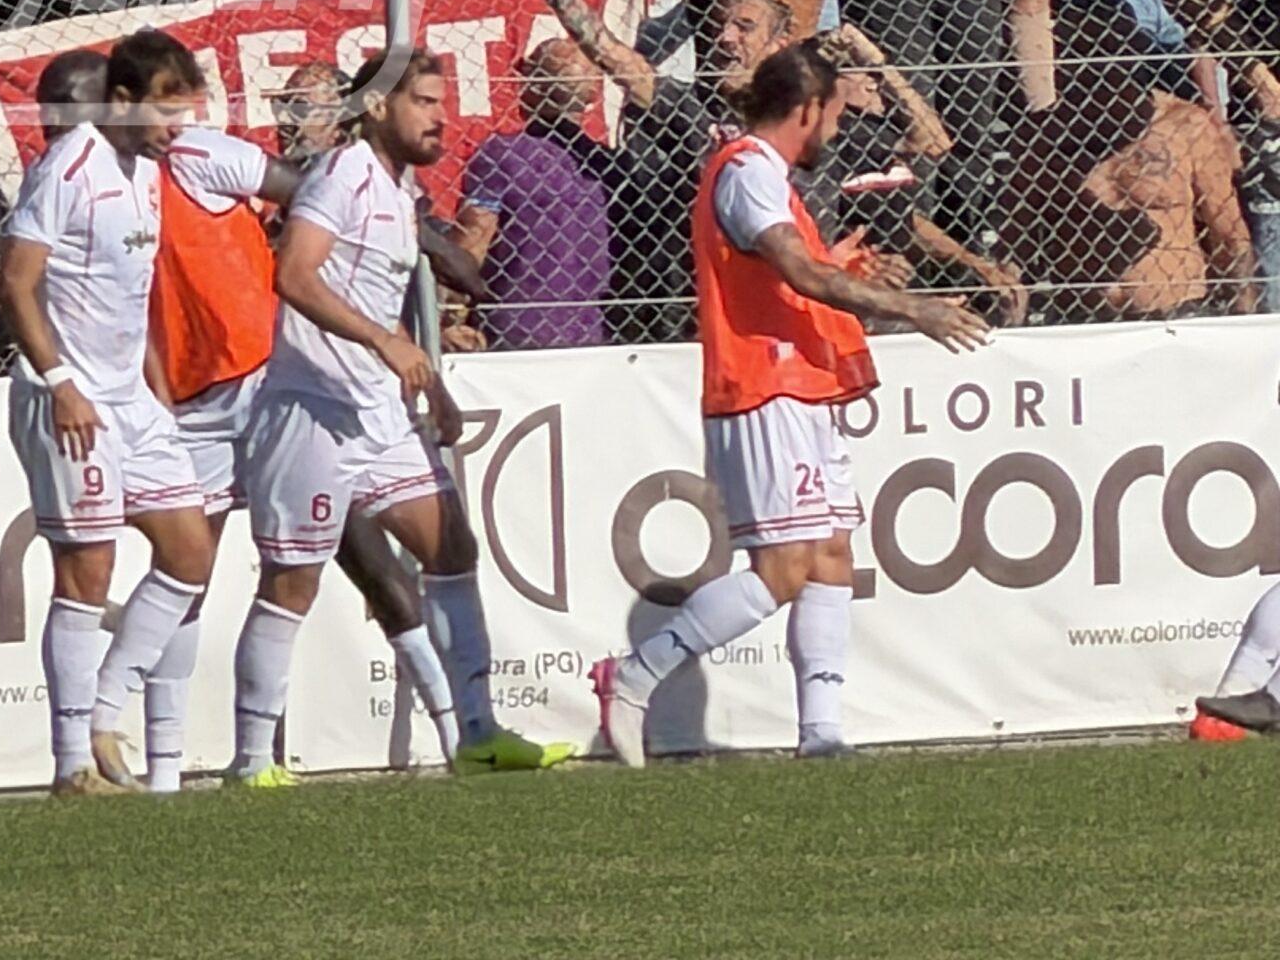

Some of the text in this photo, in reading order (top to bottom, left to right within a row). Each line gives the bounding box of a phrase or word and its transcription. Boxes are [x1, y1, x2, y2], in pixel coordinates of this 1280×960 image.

[837, 377, 1083, 438] OLORI
[83, 465, 104, 496] 9
[312, 493, 331, 523] 6
[535, 651, 584, 679] (PG)
